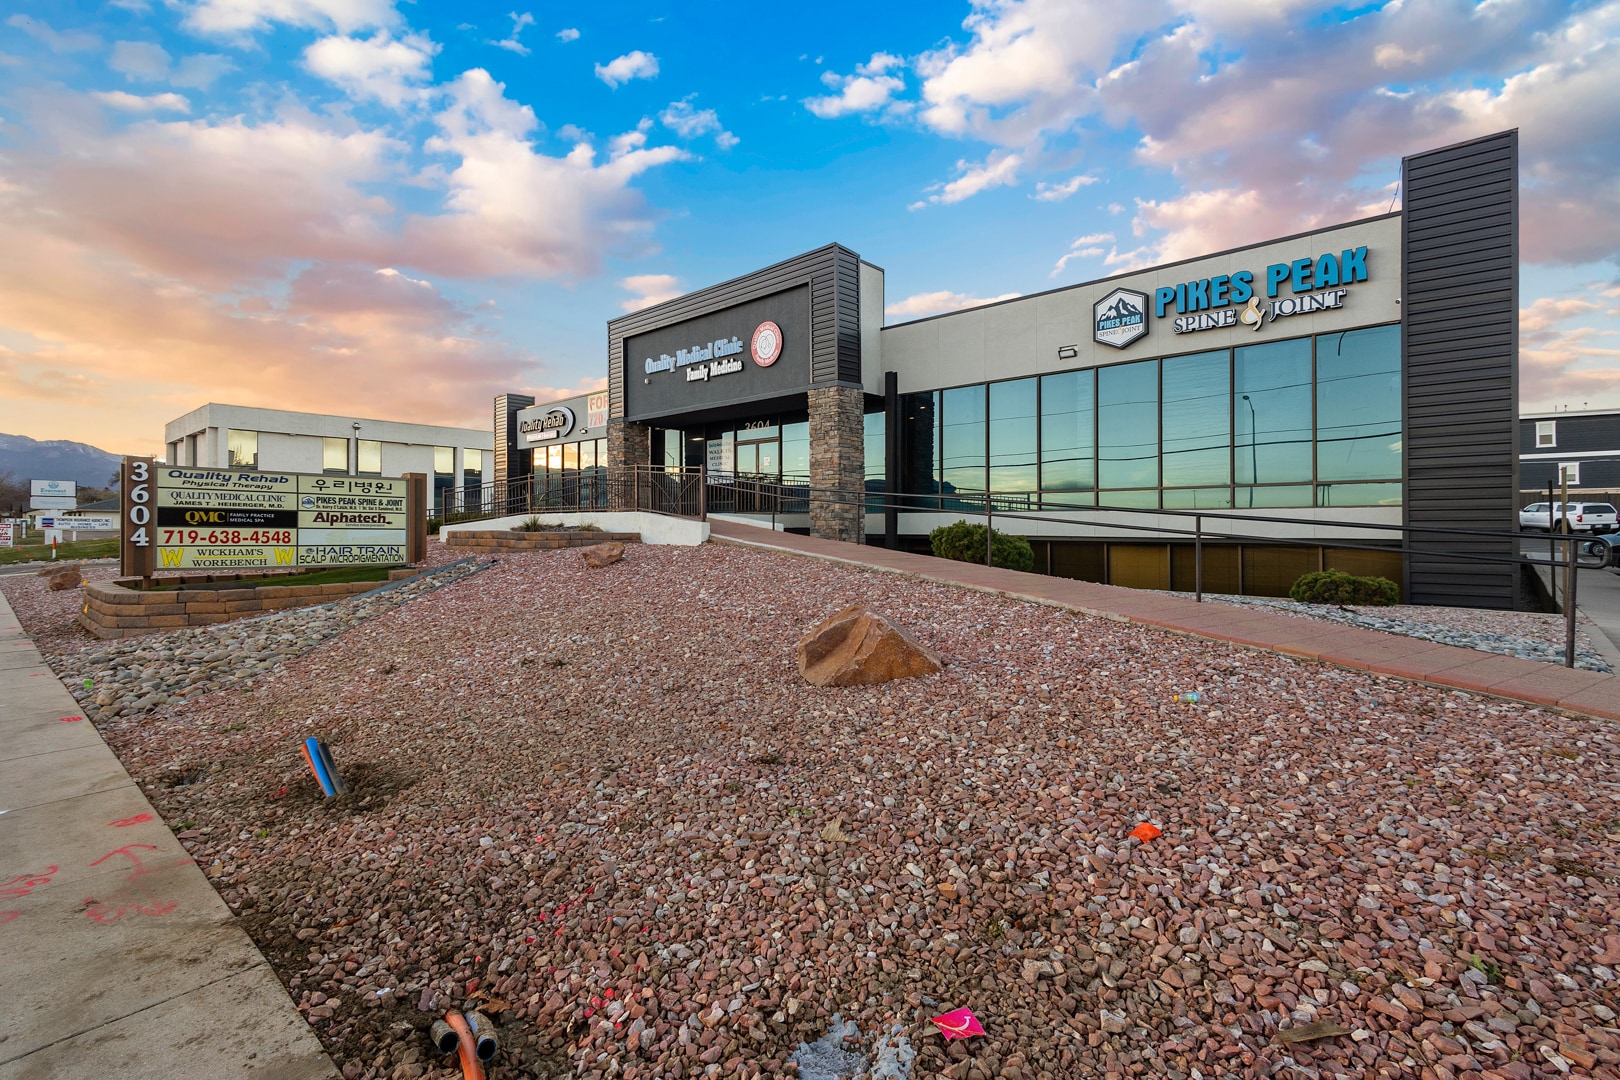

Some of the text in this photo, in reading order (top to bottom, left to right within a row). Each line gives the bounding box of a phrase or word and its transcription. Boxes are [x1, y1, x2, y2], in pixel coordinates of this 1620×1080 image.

[1155, 245, 1368, 318] PIKES PEAK
[1173, 288, 1348, 335] SPINE & JOINT
[1099, 314, 1141, 330] PIKES PEAK
[1099, 329, 1118, 337] SPINE
[1122, 325, 1141, 336] JOINT
[645, 354, 676, 374] Quality
[676, 343, 714, 367] Medical
[714, 336, 743, 357] Clinic
[686, 358, 742, 382] Family Medicine
[543, 414, 565, 429] Rehab
[168, 470, 289, 484] Quality Rehab
[181, 480, 274, 490] Physical Therapy
[311, 479, 393, 494] 우리병원
[171, 491, 214, 500] QUALITY
[214, 493, 256, 502] MEDICAL
[316, 496, 337, 505] PIKES
[338, 497, 356, 506] PEAK
[357, 498, 378, 506] SPINE
[385, 499, 403, 507] JOINT
[130, 461, 150, 547] 3604
[185, 510, 226, 525] QMC
[313, 512, 387, 526] Alphatech
[163, 530, 291, 544] 719-638-4548
[197, 549, 264, 557] WICKHAM'S
[356, 546, 400, 554] TRAIN
[192, 558, 268, 567] WORKBENCH
[299, 554, 404, 564] SCALP MICROPIGMENTATION
